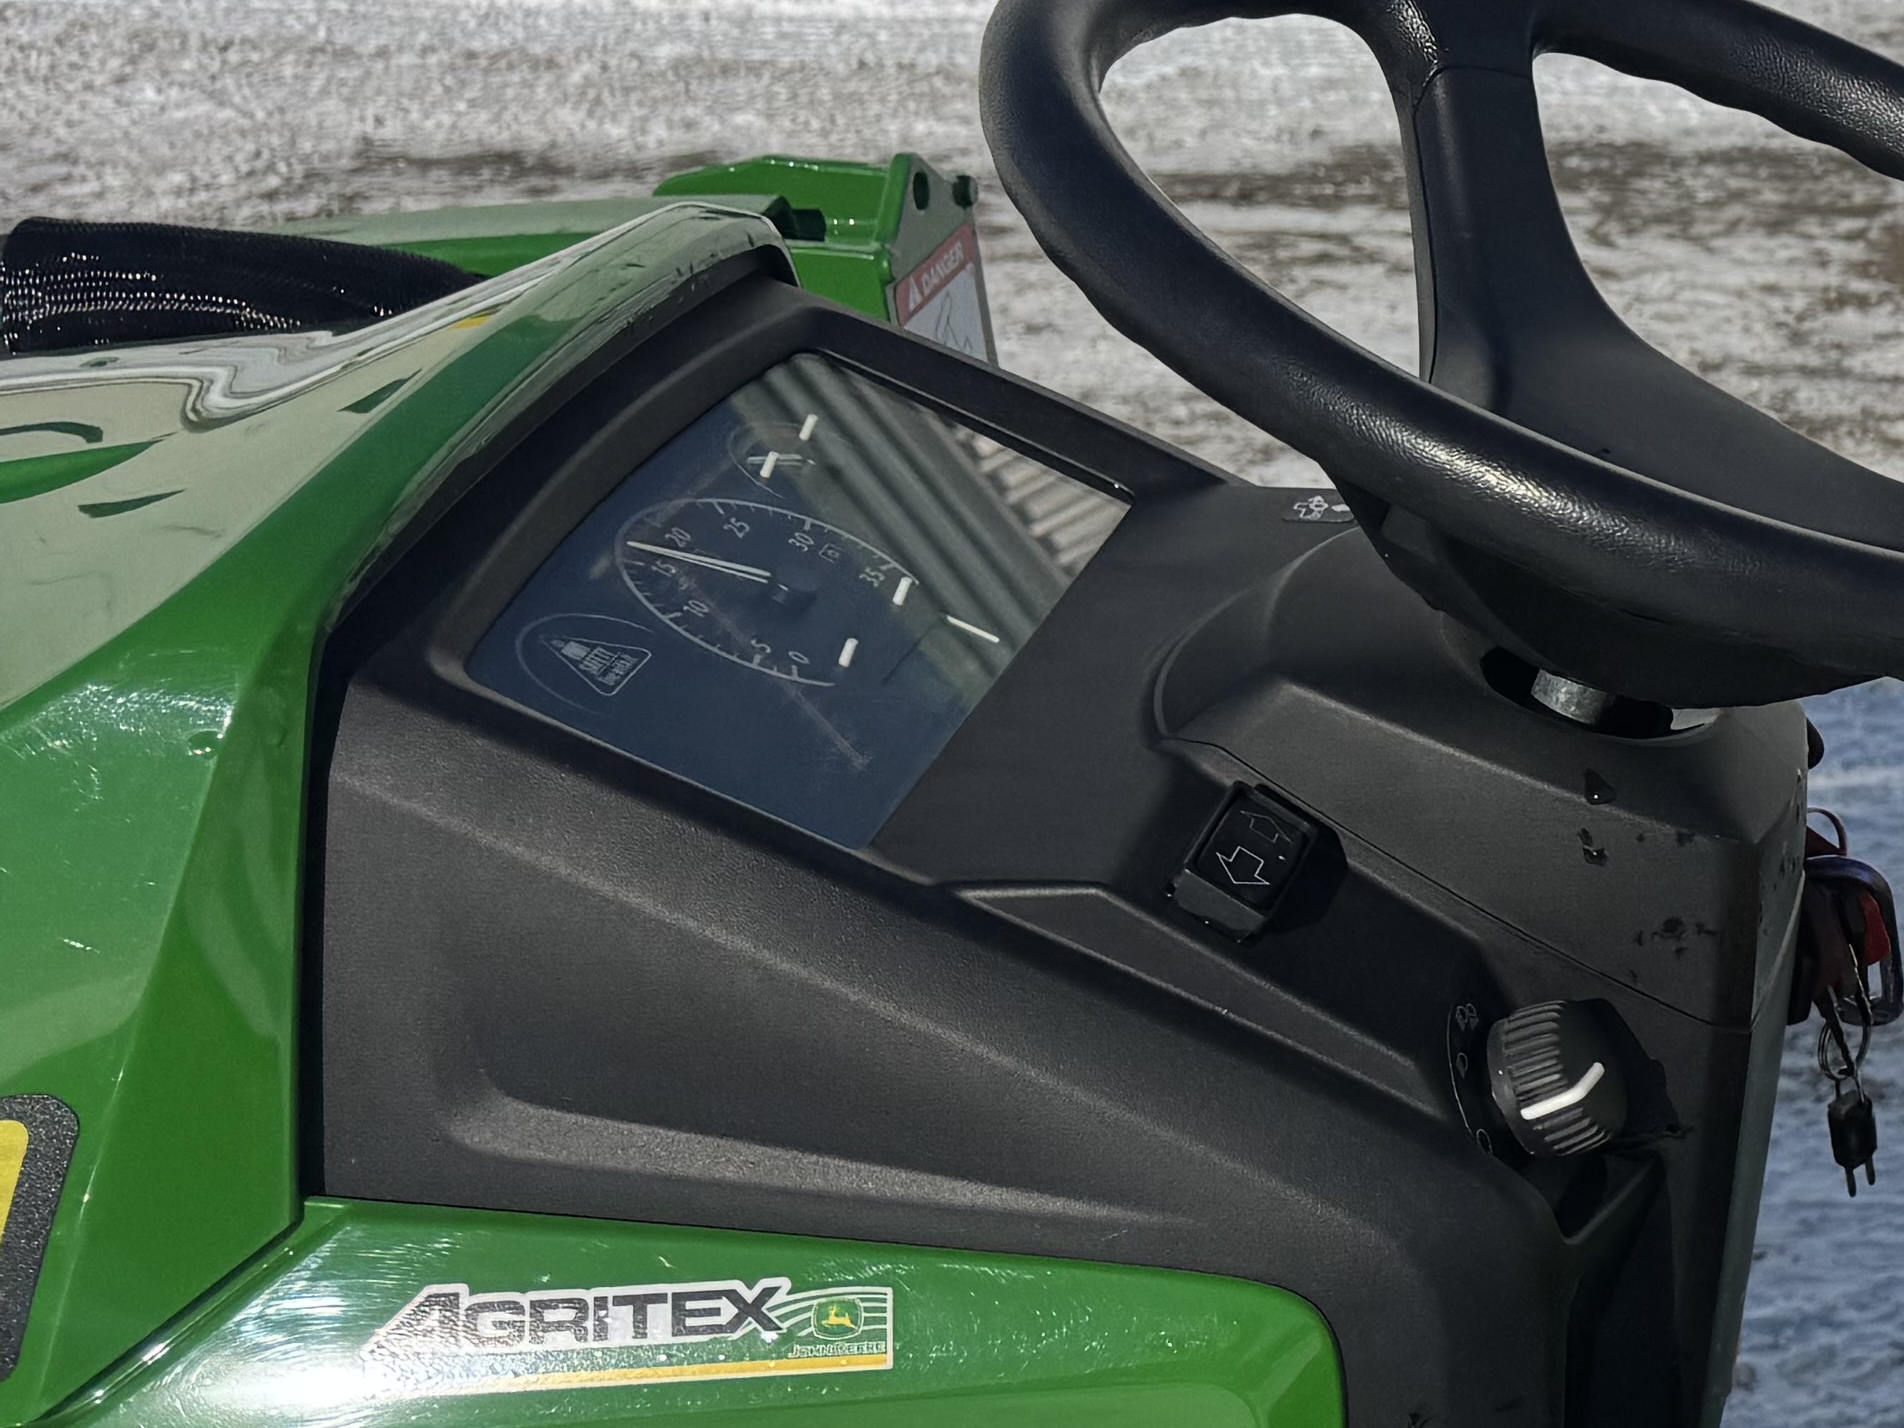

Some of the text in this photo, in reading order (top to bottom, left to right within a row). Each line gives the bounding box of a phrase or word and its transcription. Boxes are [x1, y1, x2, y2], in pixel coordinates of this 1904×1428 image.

[921, 241, 964, 297] DANGER
[665, 527, 692, 548] 20
[724, 518, 750, 540] 25
[788, 532, 814, 553] 30
[652, 562, 676, 577] 15
[859, 569, 885, 587] 35
[684, 599, 709, 617] 10
[393, 1285, 788, 1349] AGRITEX
